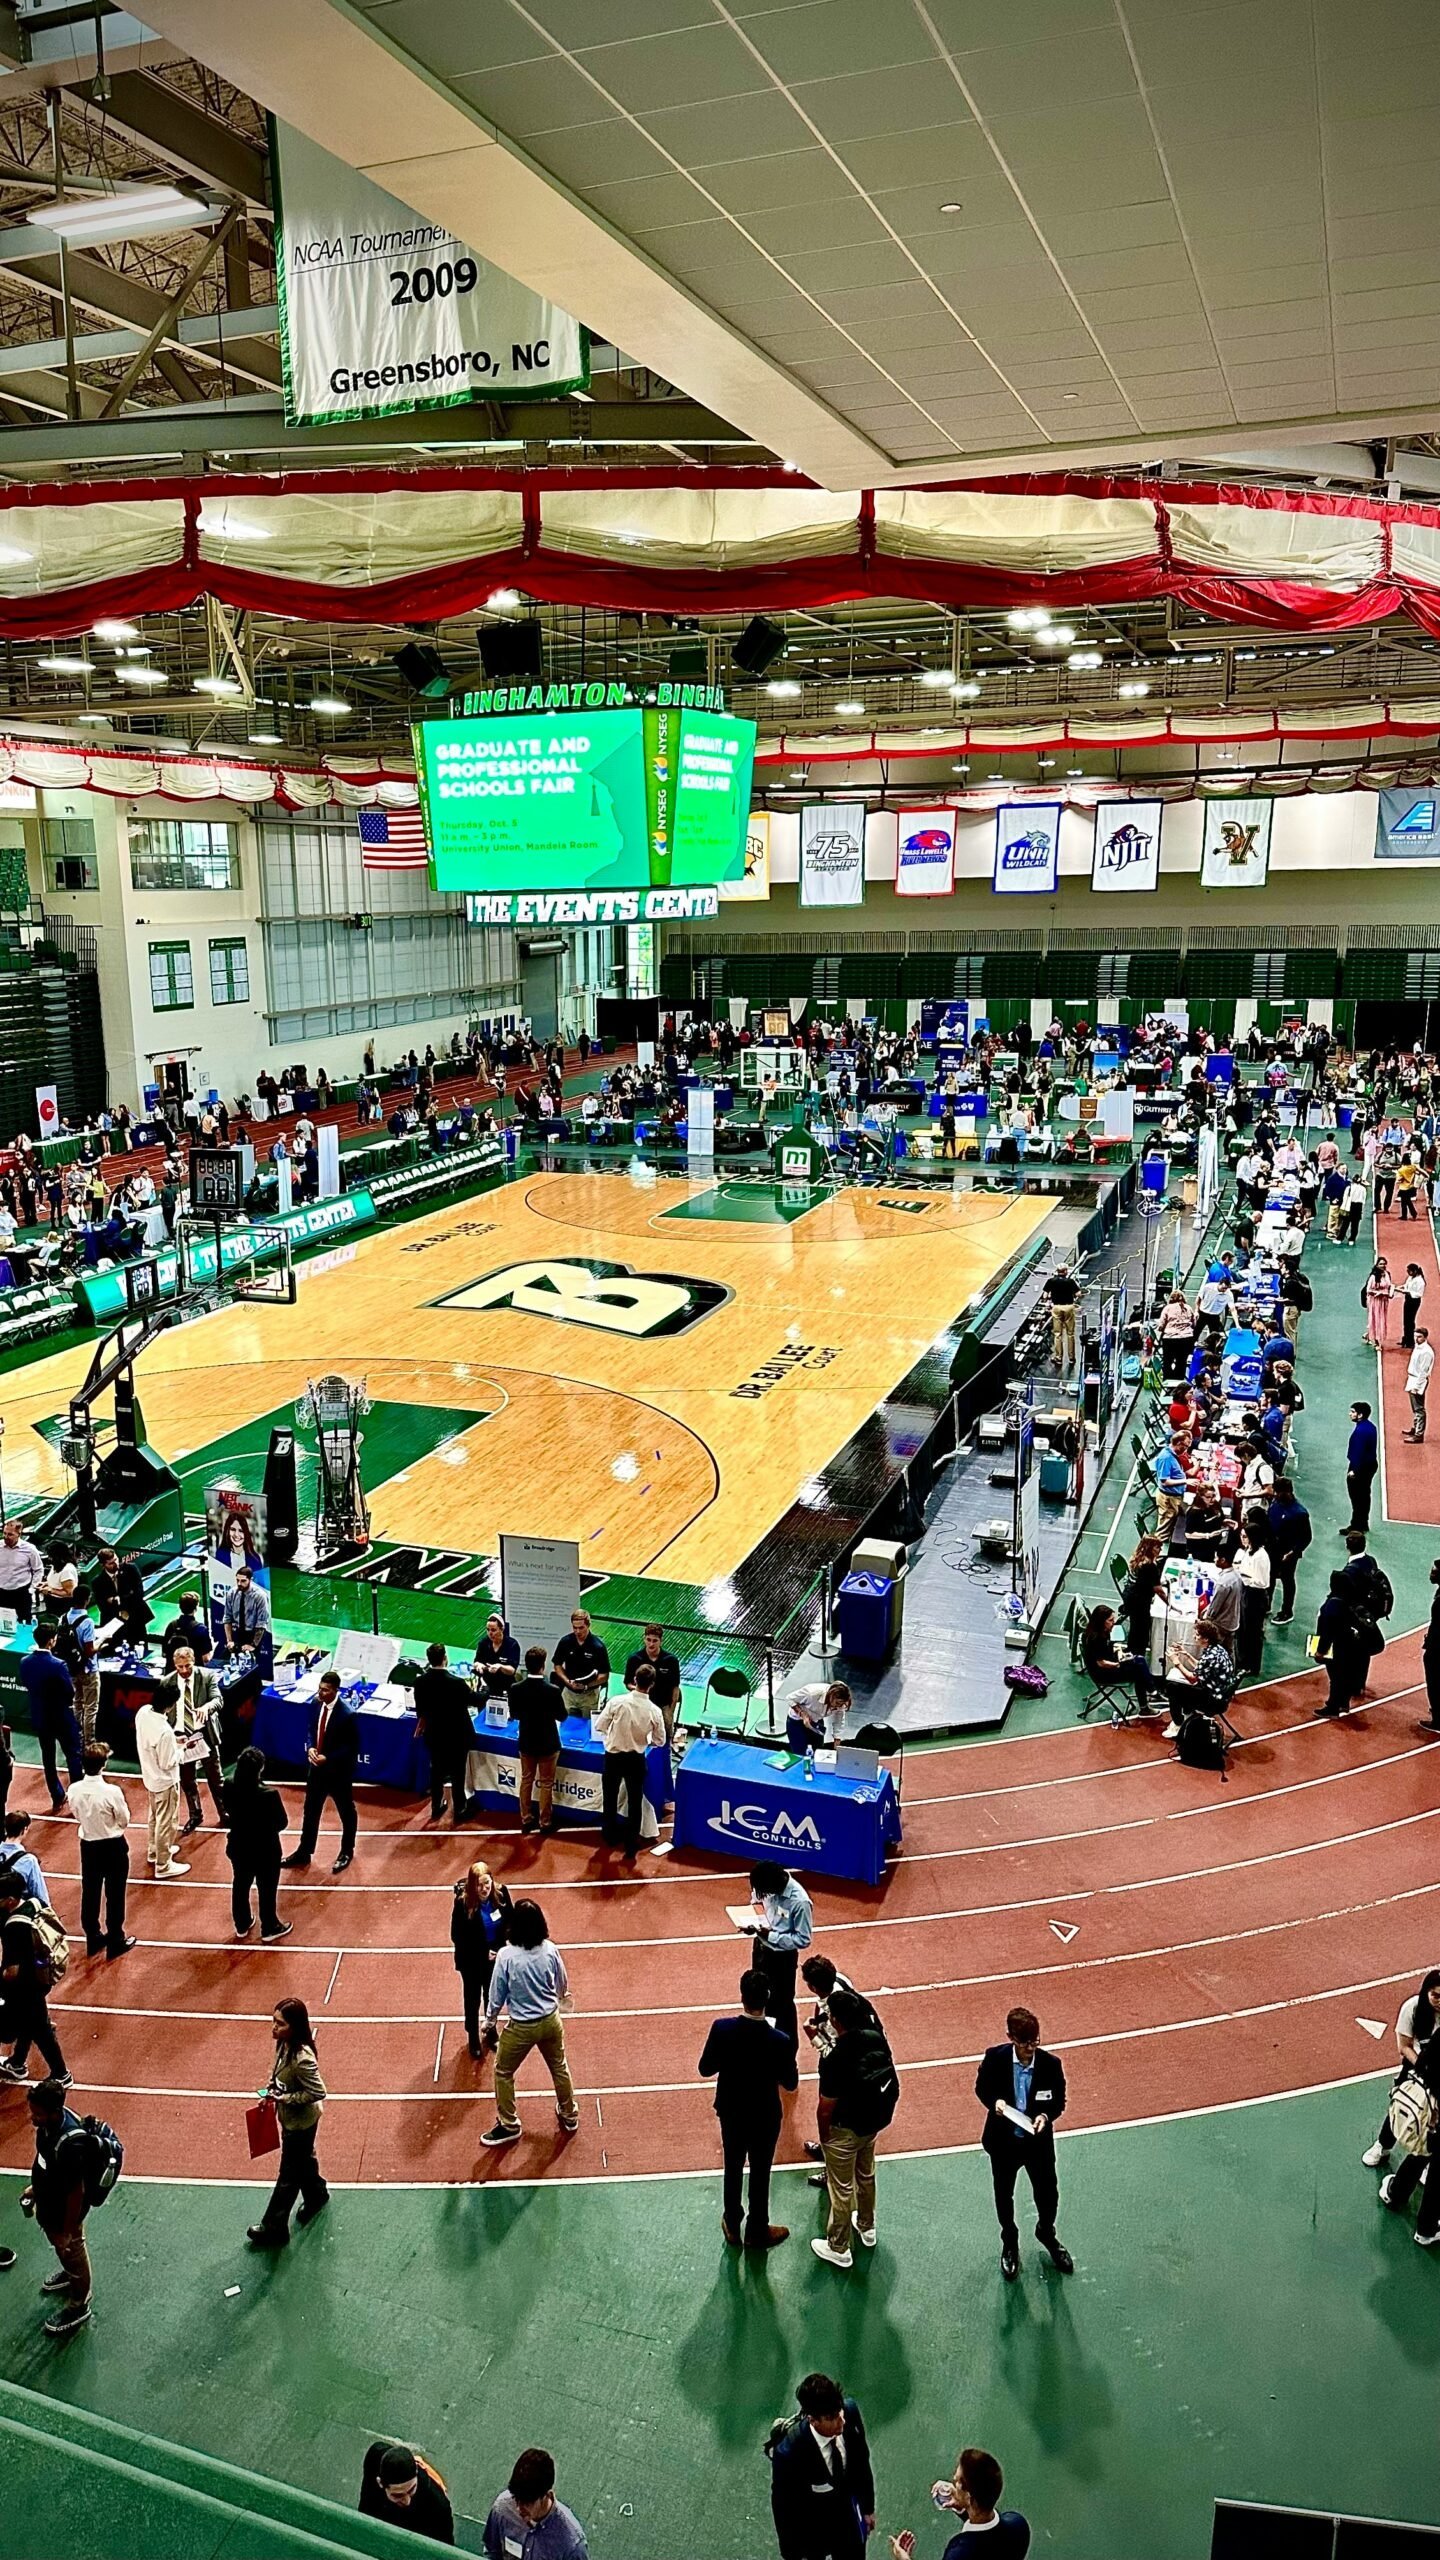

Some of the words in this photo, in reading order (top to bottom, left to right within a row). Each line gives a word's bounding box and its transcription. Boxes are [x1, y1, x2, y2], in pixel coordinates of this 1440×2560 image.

[294, 238, 344, 266] NCAA
[350, 225, 452, 256] Tourname
[390, 257, 478, 306] 2009
[330, 350, 500, 394] Greensboro,
[512, 340, 550, 372] NC
[463, 681, 627, 716] BINGHAMTON
[658, 713, 668, 755] NYSEG
[435, 739, 542, 760] GRADUATE
[547, 736, 591, 755] AND
[437, 757, 582, 779] PROFESSIONAL
[438, 779, 525, 799] SCHOOLS
[530, 776, 575, 794] FAIR
[657, 789, 667, 830] NYSEG
[814, 835, 851, 860] 75
[1008, 846, 1048, 861] UNH
[1100, 835, 1153, 872] NJIT
[1006, 860, 1047, 868] WILDCATS
[475, 895, 512, 922] THE
[515, 891, 640, 923] EVENTS
[306, 1198, 358, 1232] CENTER
[728, 1382, 776, 1399] DR.
[771, 1343, 817, 1363] LEE
[801, 1347, 844, 1370] Court
[273, 1436, 294, 1457] B
[219, 1491, 241, 1502] NBT
[225, 1502, 254, 1513] BANK
[508, 1560, 529, 1568] What's
[721, 1800, 821, 1842] ICM
[752, 1830, 823, 1850] CONTROLS
